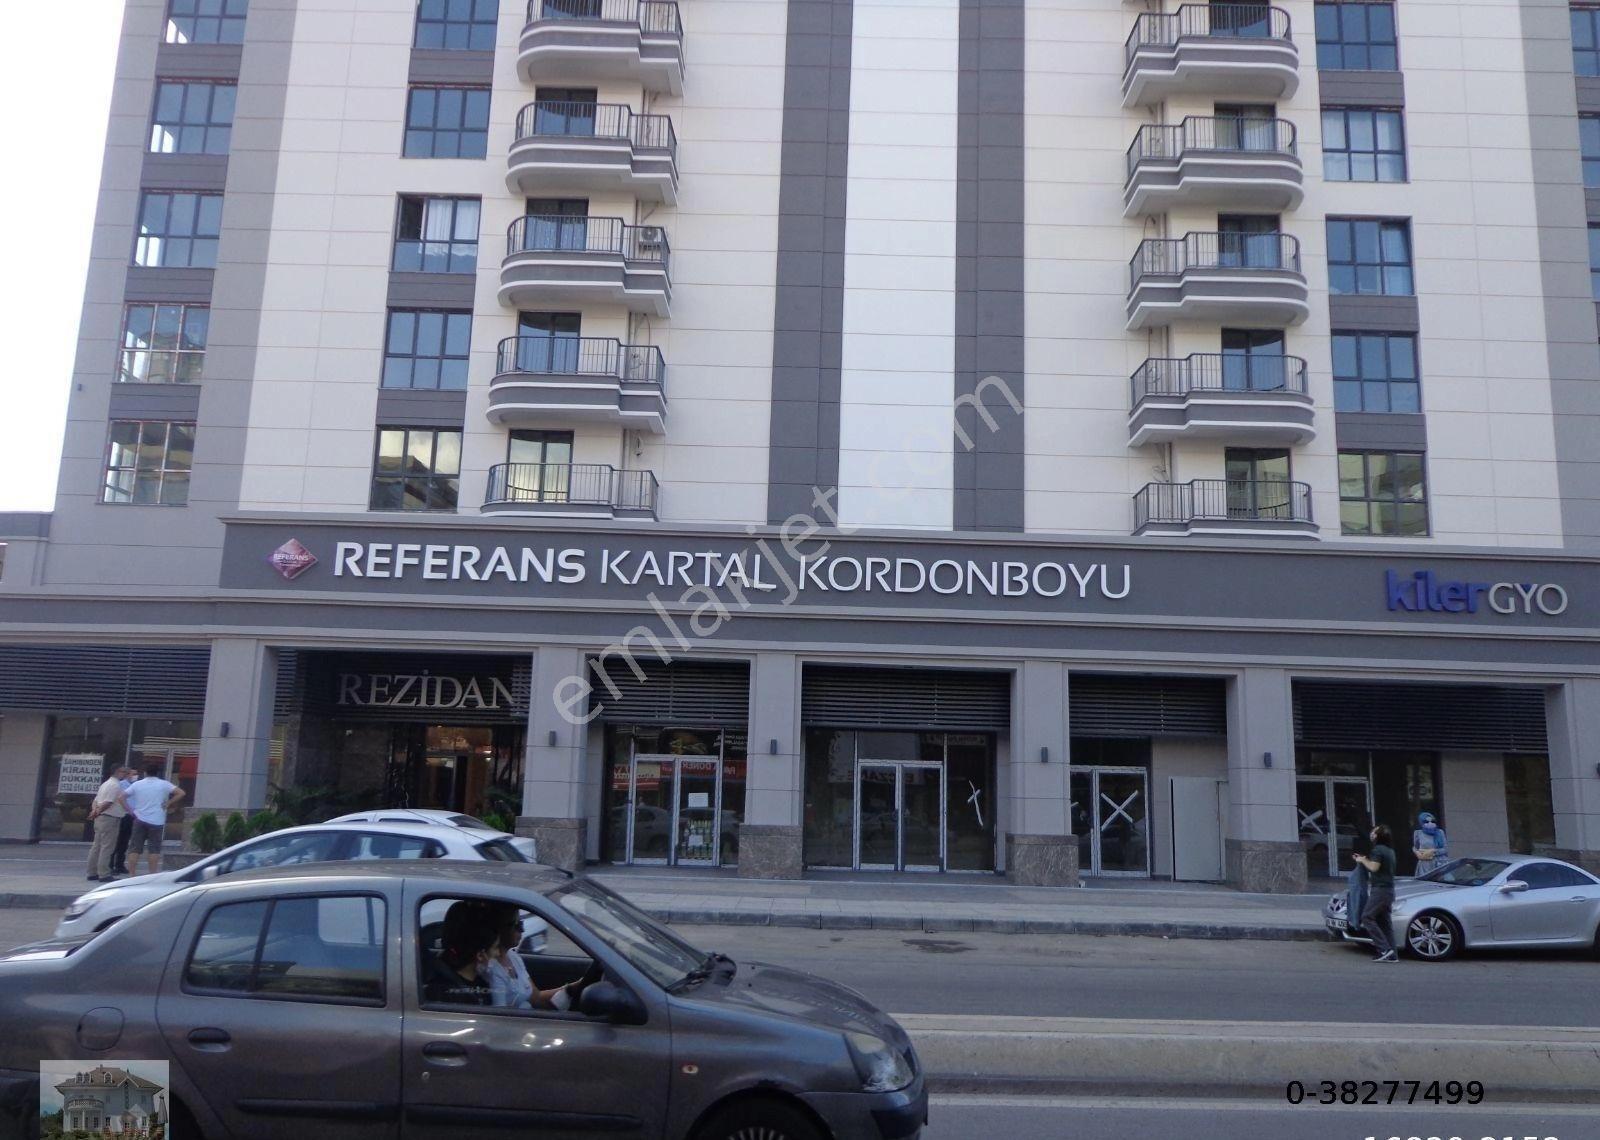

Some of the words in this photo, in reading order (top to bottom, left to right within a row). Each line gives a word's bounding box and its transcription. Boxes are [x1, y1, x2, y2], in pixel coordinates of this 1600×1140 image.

[333, 541, 586, 584] REFERANS
[600, 548, 777, 590] KARTAL
[799, 555, 1132, 599] KORDONBOYU
